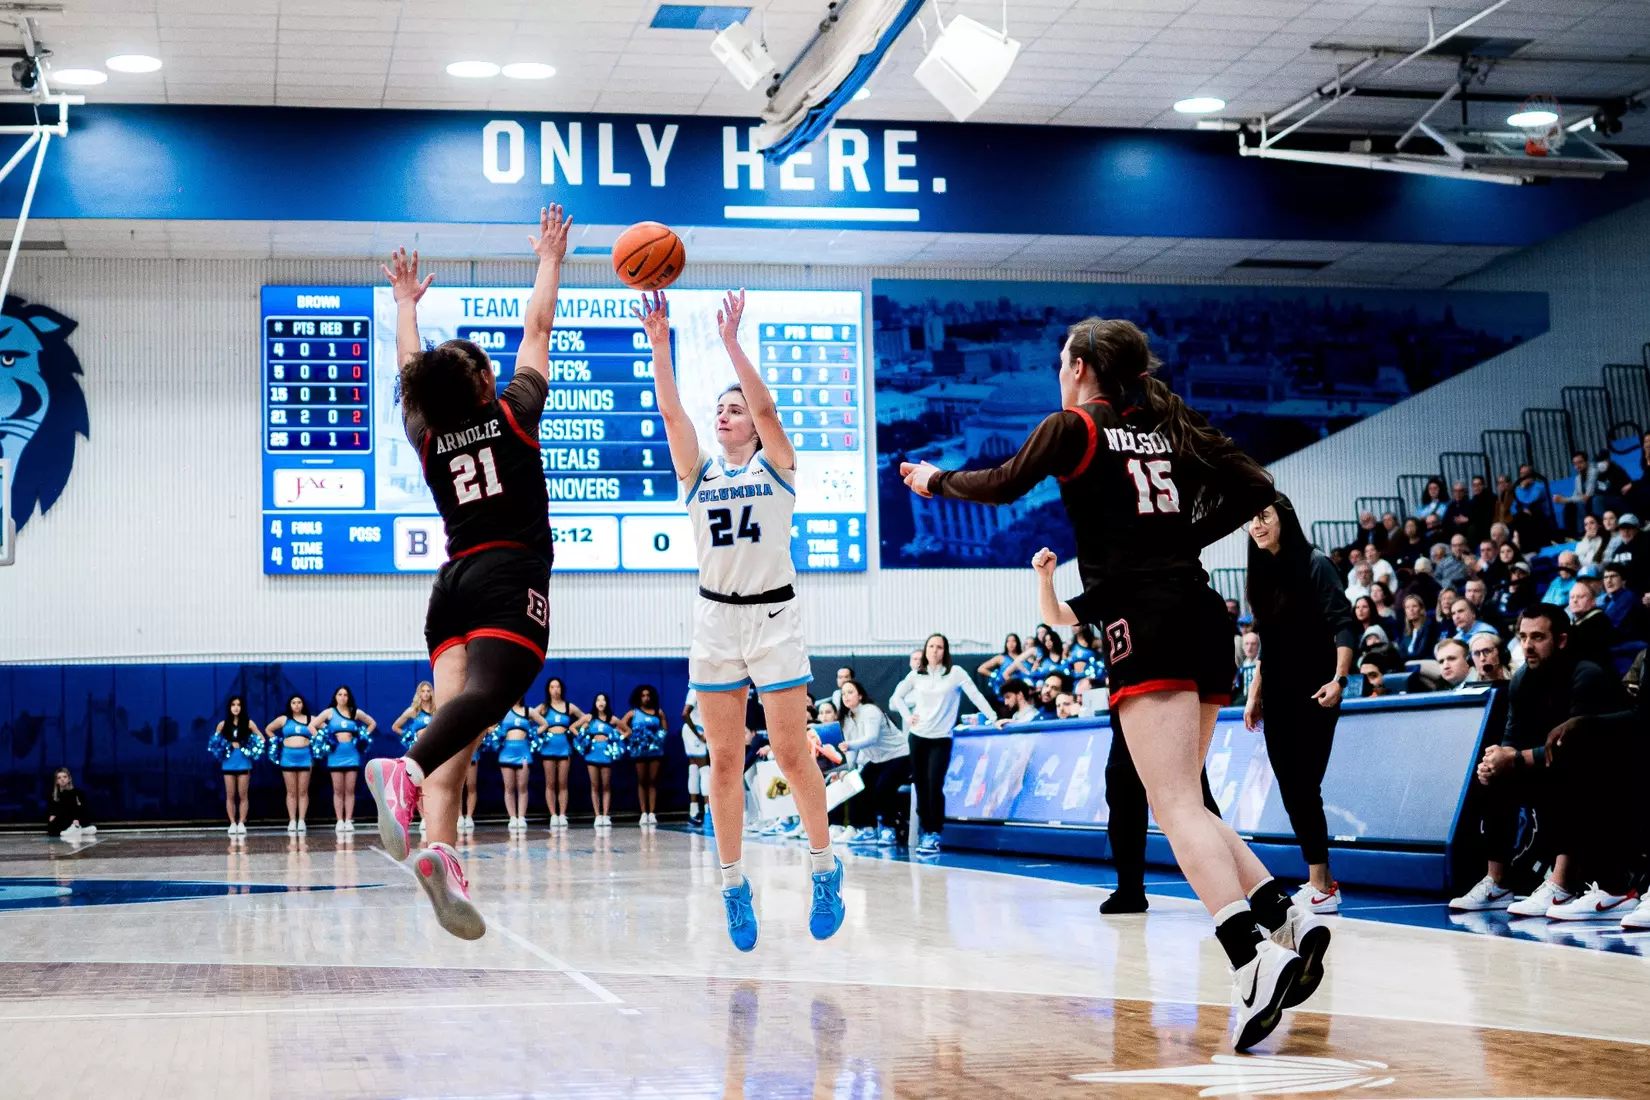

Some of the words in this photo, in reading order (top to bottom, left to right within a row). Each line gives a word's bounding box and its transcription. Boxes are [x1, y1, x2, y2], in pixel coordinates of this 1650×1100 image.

[482, 119, 679, 187] ONLY
[297, 295, 340, 308] BROWN
[461, 298, 519, 317] TEAM
[293, 321, 315, 335] PTS
[320, 321, 343, 335] REB
[353, 321, 361, 336] F
[273, 342, 284, 357] 4
[300, 342, 310, 357] 0
[328, 342, 337, 357] 1
[352, 343, 361, 356] 0
[300, 364, 310, 379] 0
[328, 364, 338, 379] 0
[352, 365, 361, 379] 0
[270, 387, 288, 401] 15
[300, 387, 310, 401] 0
[328, 387, 337, 401] 1
[353, 388, 360, 401] 1
[544, 389, 614, 411] BOUNDS
[270, 409, 287, 424] 21
[300, 409, 310, 424] 2
[328, 409, 338, 424] 0
[352, 410, 361, 423] 2
[436, 419, 502, 455] ARNOLIE
[640, 419, 654, 437] 0
[300, 432, 310, 446] 0
[328, 432, 338, 446] 1
[353, 432, 360, 446] 1
[642, 449, 654, 467] 1
[448, 446, 503, 505] 21
[642, 478, 654, 496] 1
[697, 483, 774, 503] COLUMBIA
[1126, 457, 1181, 515] 15
[270, 519, 283, 539] 4
[291, 520, 323, 535] FOULS
[349, 526, 382, 542] POSS
[706, 504, 763, 548] 24
[406, 528, 429, 557] B
[653, 532, 671, 552] 0
[270, 546, 283, 566] 4
[291, 541, 323, 555] TIME
[291, 556, 324, 570] OUTS
